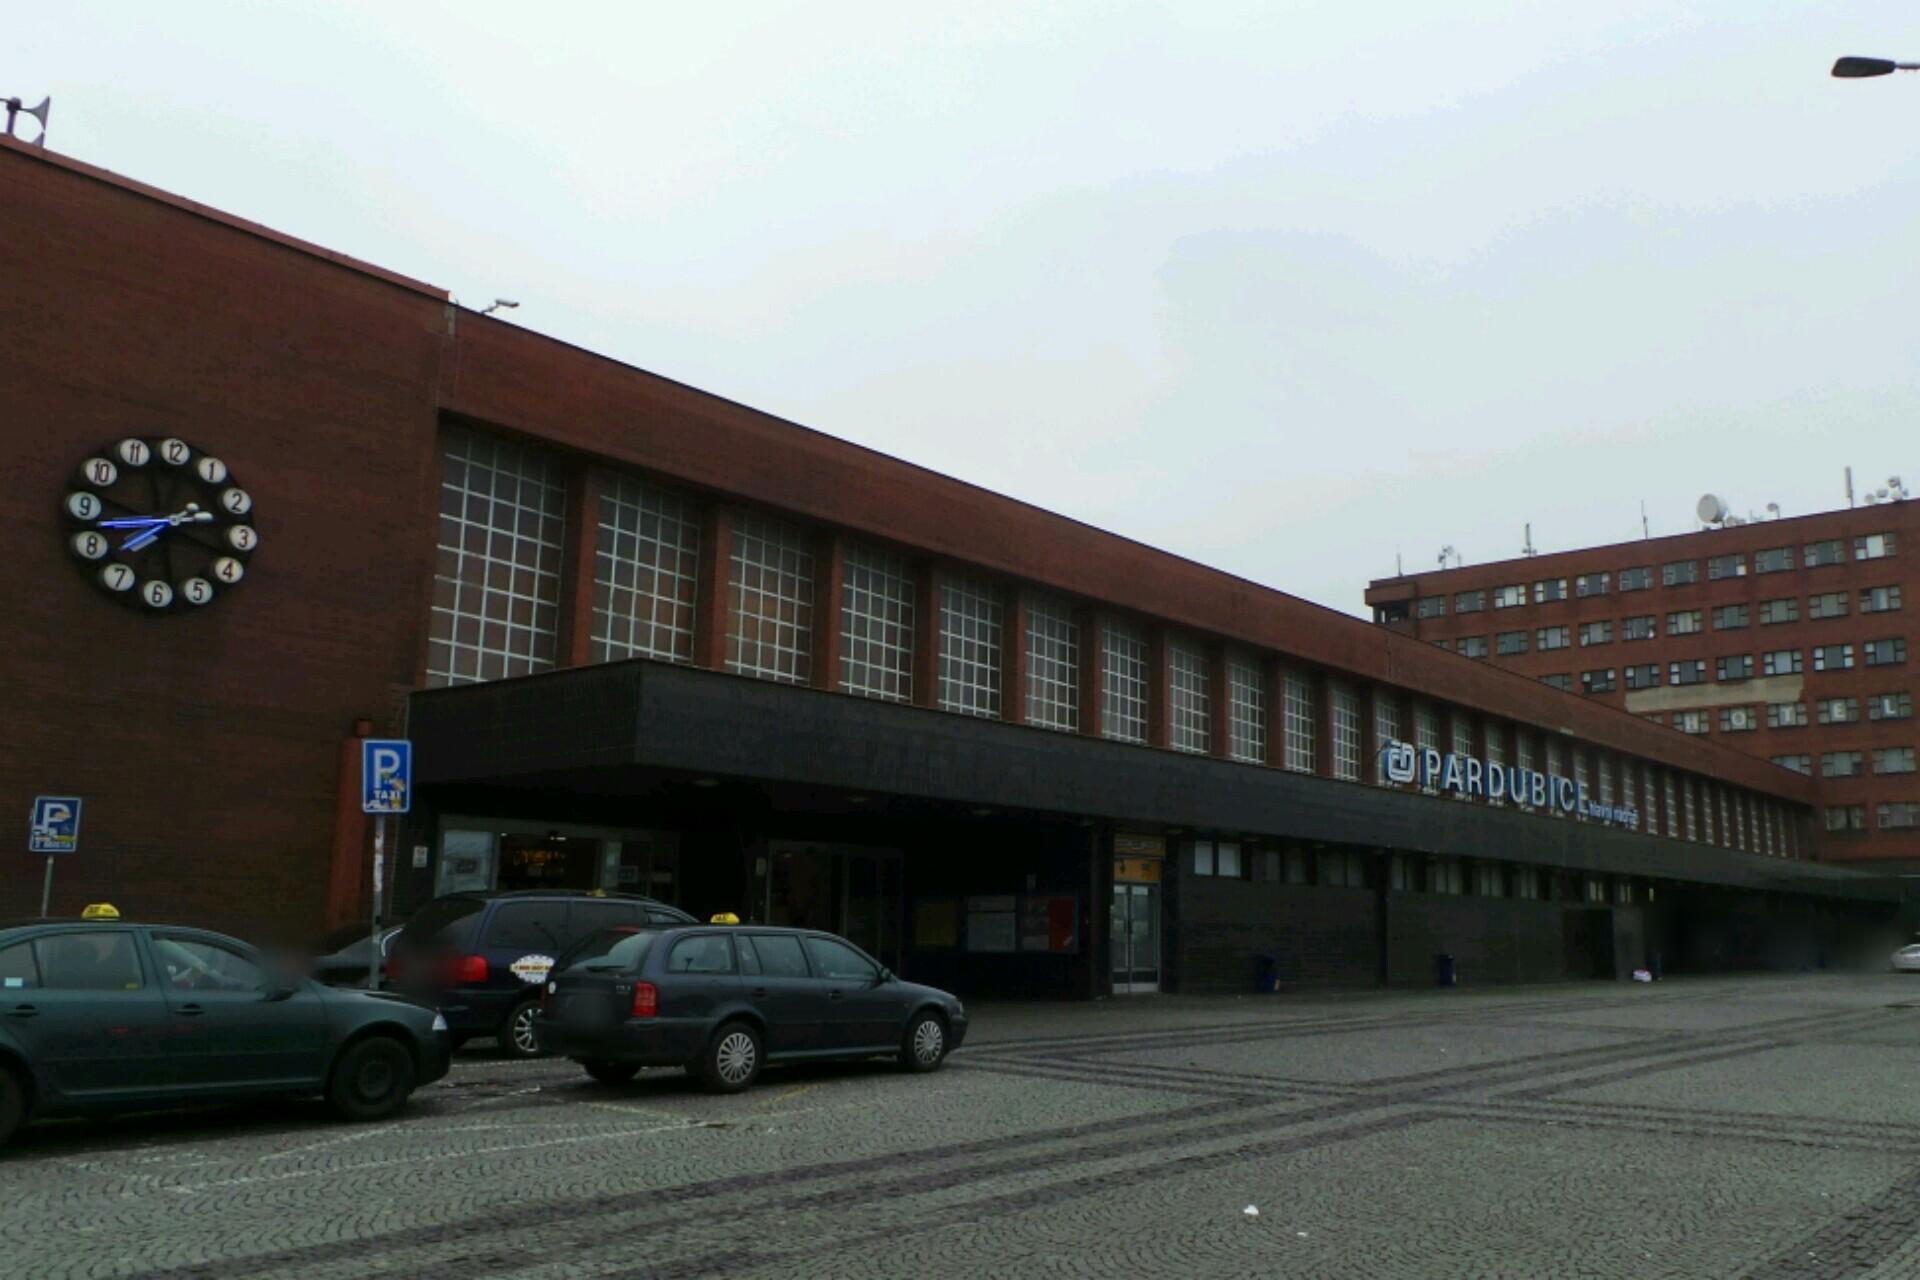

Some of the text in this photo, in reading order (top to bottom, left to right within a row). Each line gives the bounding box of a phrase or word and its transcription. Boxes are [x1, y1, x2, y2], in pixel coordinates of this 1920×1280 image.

[129, 440, 142, 464] 11
[169, 442, 183, 464] 12
[94, 463, 110, 484] 10
[207, 461, 215, 481] 1
[79, 496, 91, 516] 9
[231, 492, 242, 512] 2
[86, 535, 98, 556] 8
[238, 528, 249, 548] 3
[114, 568, 126, 588] 7
[222, 561, 233, 578] 4
[152, 584, 164, 604] 6
[193, 581, 204, 601] 5
[1683, 698, 1895, 733] HOTEL
[374, 749, 400, 788] P
[1421, 748, 1589, 813] PARDUBICE
[43, 803, 71, 834] P
